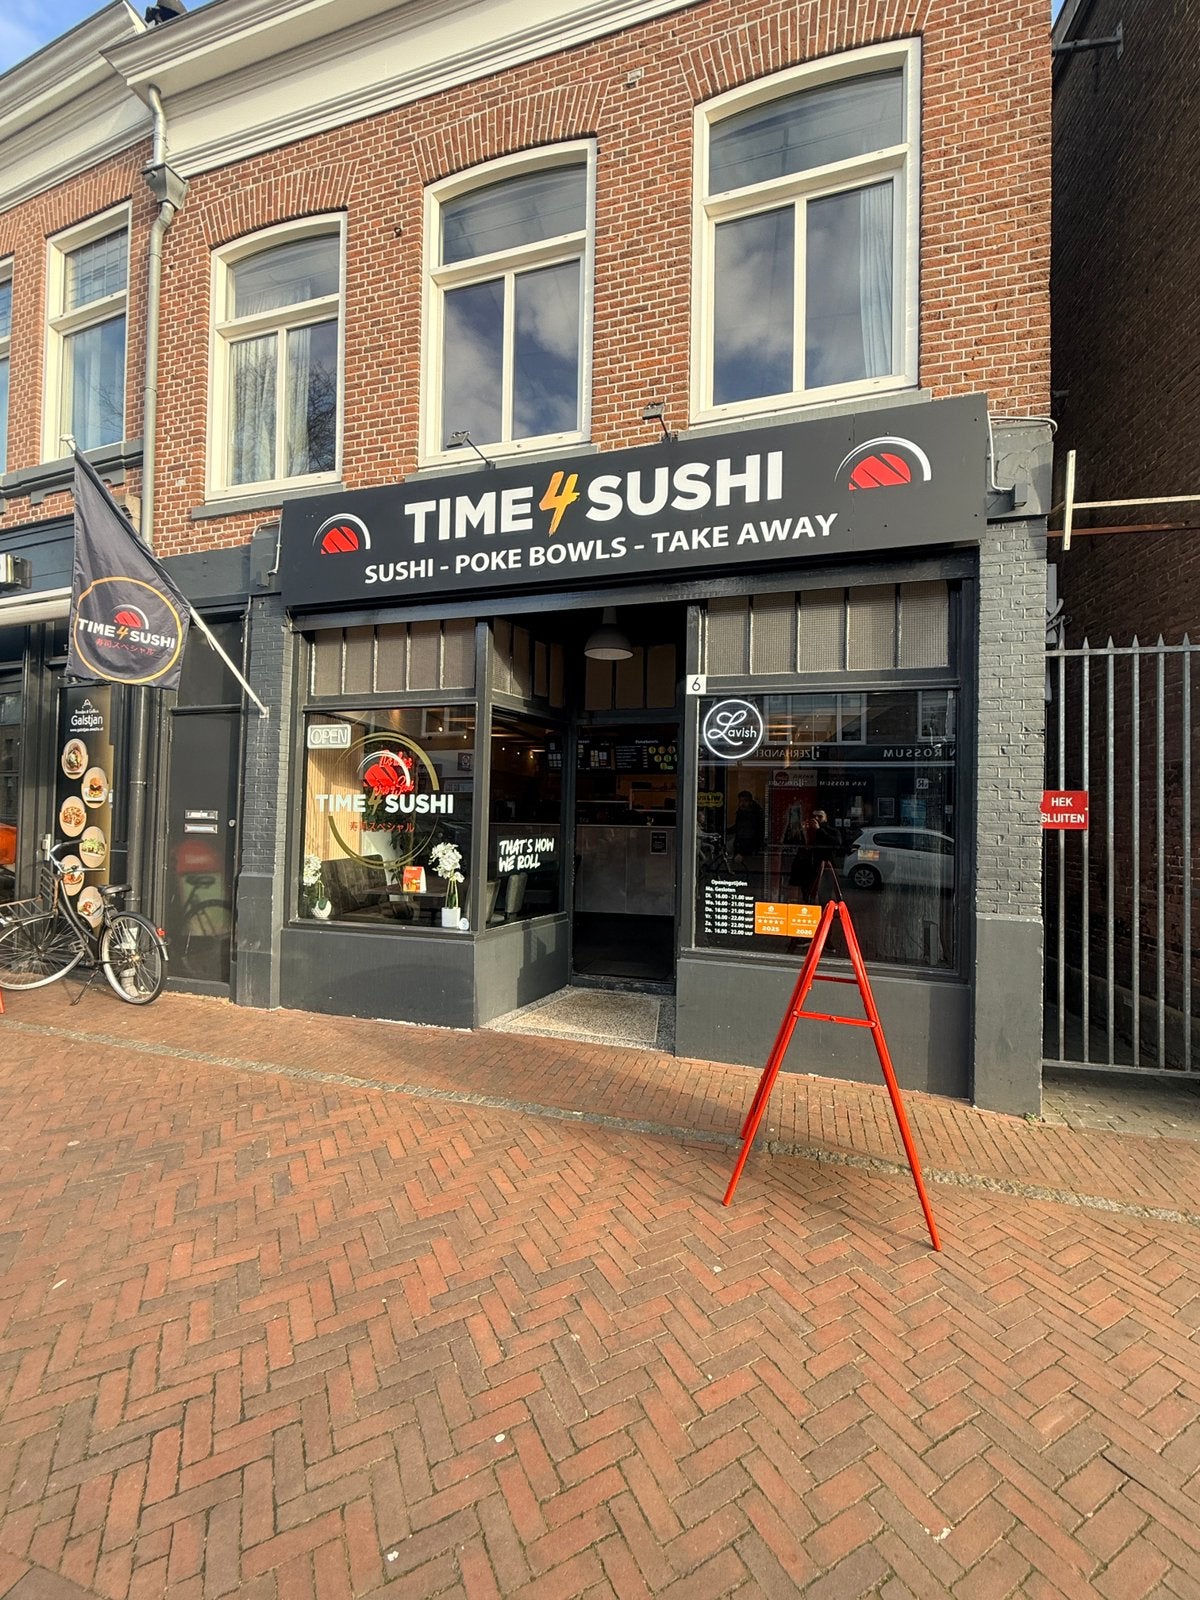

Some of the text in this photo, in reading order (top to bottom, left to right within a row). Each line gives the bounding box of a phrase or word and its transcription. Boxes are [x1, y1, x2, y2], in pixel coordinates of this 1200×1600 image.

[404, 450, 783, 544] TIME 4 SUSHI
[364, 558, 434, 584] SUSHI
[455, 548, 522, 574] POKE
[529, 536, 627, 567] BOWLS
[652, 524, 729, 553] TAKE
[737, 512, 838, 546] AWAY
[78, 618, 176, 649] TIME 4 SUSHI
[691, 676, 701, 692] 6
[70, 714, 103, 727] Galstjan
[707, 710, 757, 746] Lavish
[311, 728, 348, 744] OPEN
[315, 794, 366, 813] TIME
[385, 794, 454, 814] SUSHI
[1051, 797, 1073, 807] HEK
[1041, 813, 1085, 823] SLUITEN
[499, 837, 555, 855] THAT'S HOW
[499, 853, 541, 872] WE ROLL
